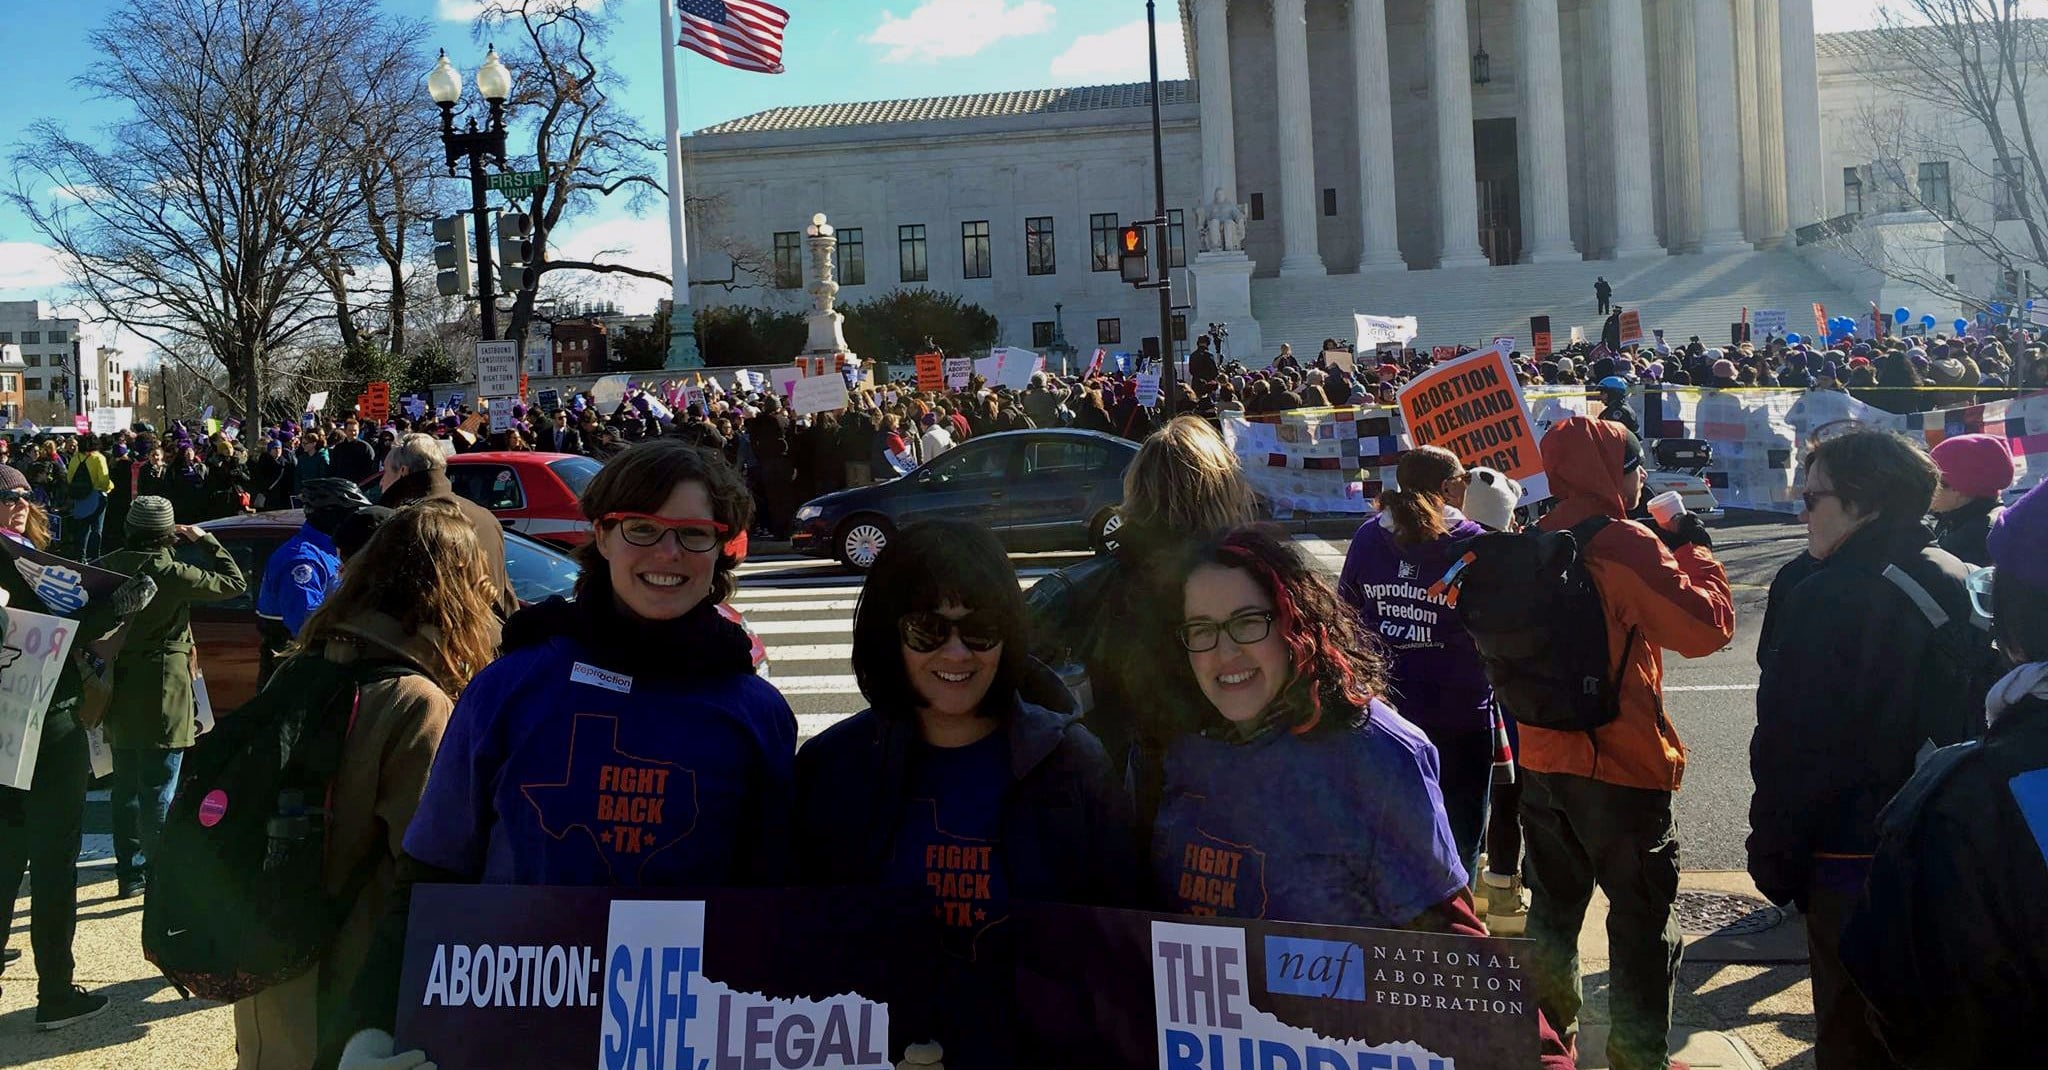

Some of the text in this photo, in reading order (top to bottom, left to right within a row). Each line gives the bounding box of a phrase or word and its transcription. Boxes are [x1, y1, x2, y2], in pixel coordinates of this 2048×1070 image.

[490, 173, 530, 188] FIRST
[504, 188, 529, 197] UNIT
[479, 356, 515, 364] CONSTITUTION
[481, 346, 511, 354] EASTBOUND
[1411, 364, 1499, 419] ABORTION
[1414, 389, 1514, 446] ON DEMAND
[1376, 601, 1438, 625] Freedom
[1380, 620, 1432, 642] For All!
[600, 765, 670, 794] FIGHT
[597, 795, 665, 824] BACK
[614, 825, 641, 853] TX
[925, 844, 992, 871] FIGHT
[1183, 843, 1243, 879] FIGHT
[926, 873, 992, 900] BACK
[1178, 872, 1237, 909] BACK
[945, 902, 973, 928] TX
[1278, 943, 1353, 999] naf
[1372, 945, 1521, 970] NATIONAL
[423, 943, 600, 1008] ABORTION:
[1158, 941, 1243, 1030] THE
[1374, 969, 1522, 993] ABORTION
[1375, 989, 1524, 1016] FEDERATION
[715, 994, 882, 1070] LEGAL
